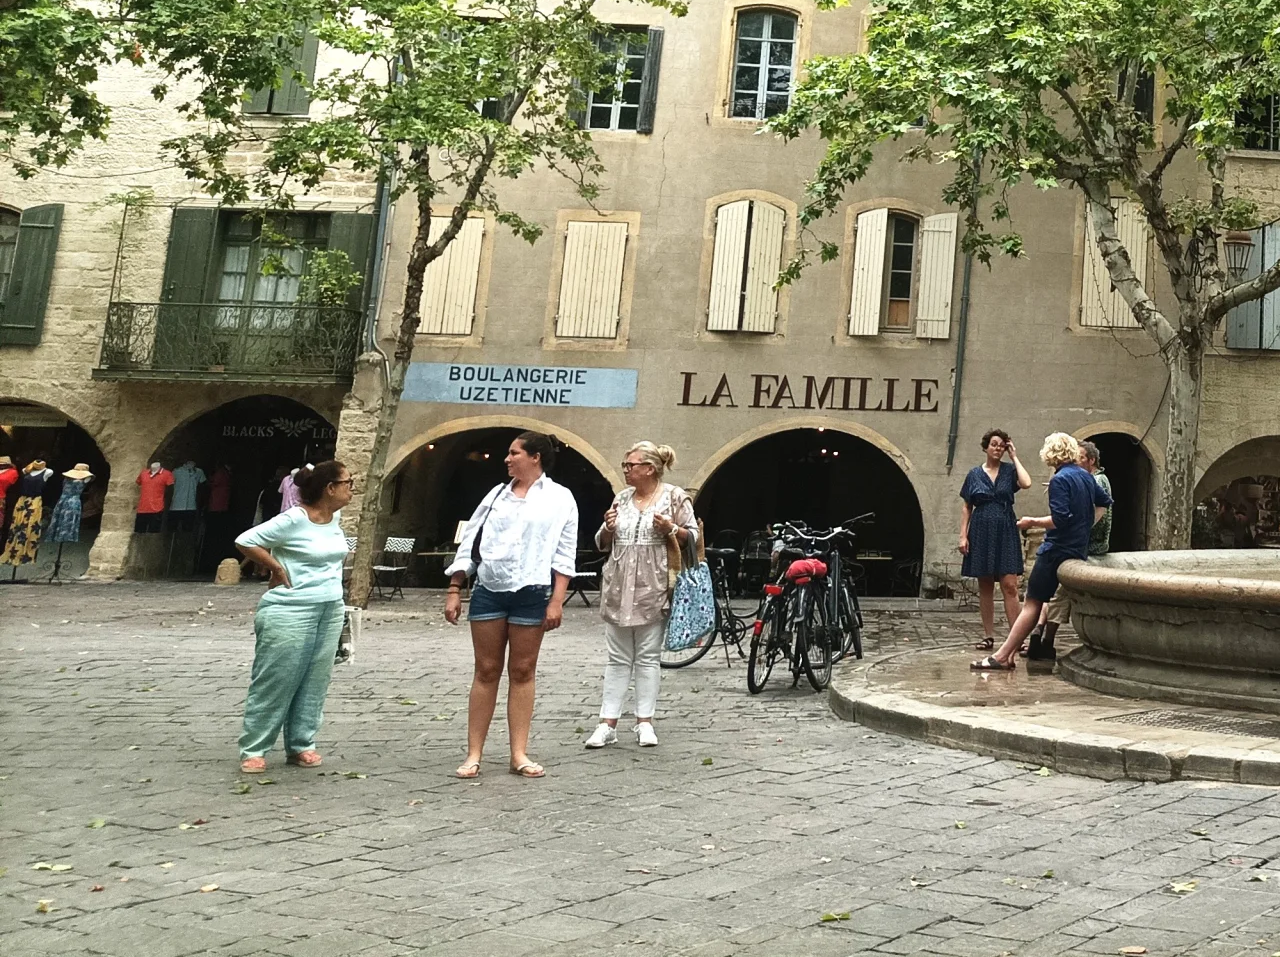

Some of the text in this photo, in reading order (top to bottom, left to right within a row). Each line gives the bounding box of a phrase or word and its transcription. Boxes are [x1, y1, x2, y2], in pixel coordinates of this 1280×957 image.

[448, 365, 588, 385] BOULANGERIE
[458, 386, 573, 405] UZETIENNE
[676, 371, 940, 413] LA FAMILLE
[222, 425, 275, 438] BLACKS
